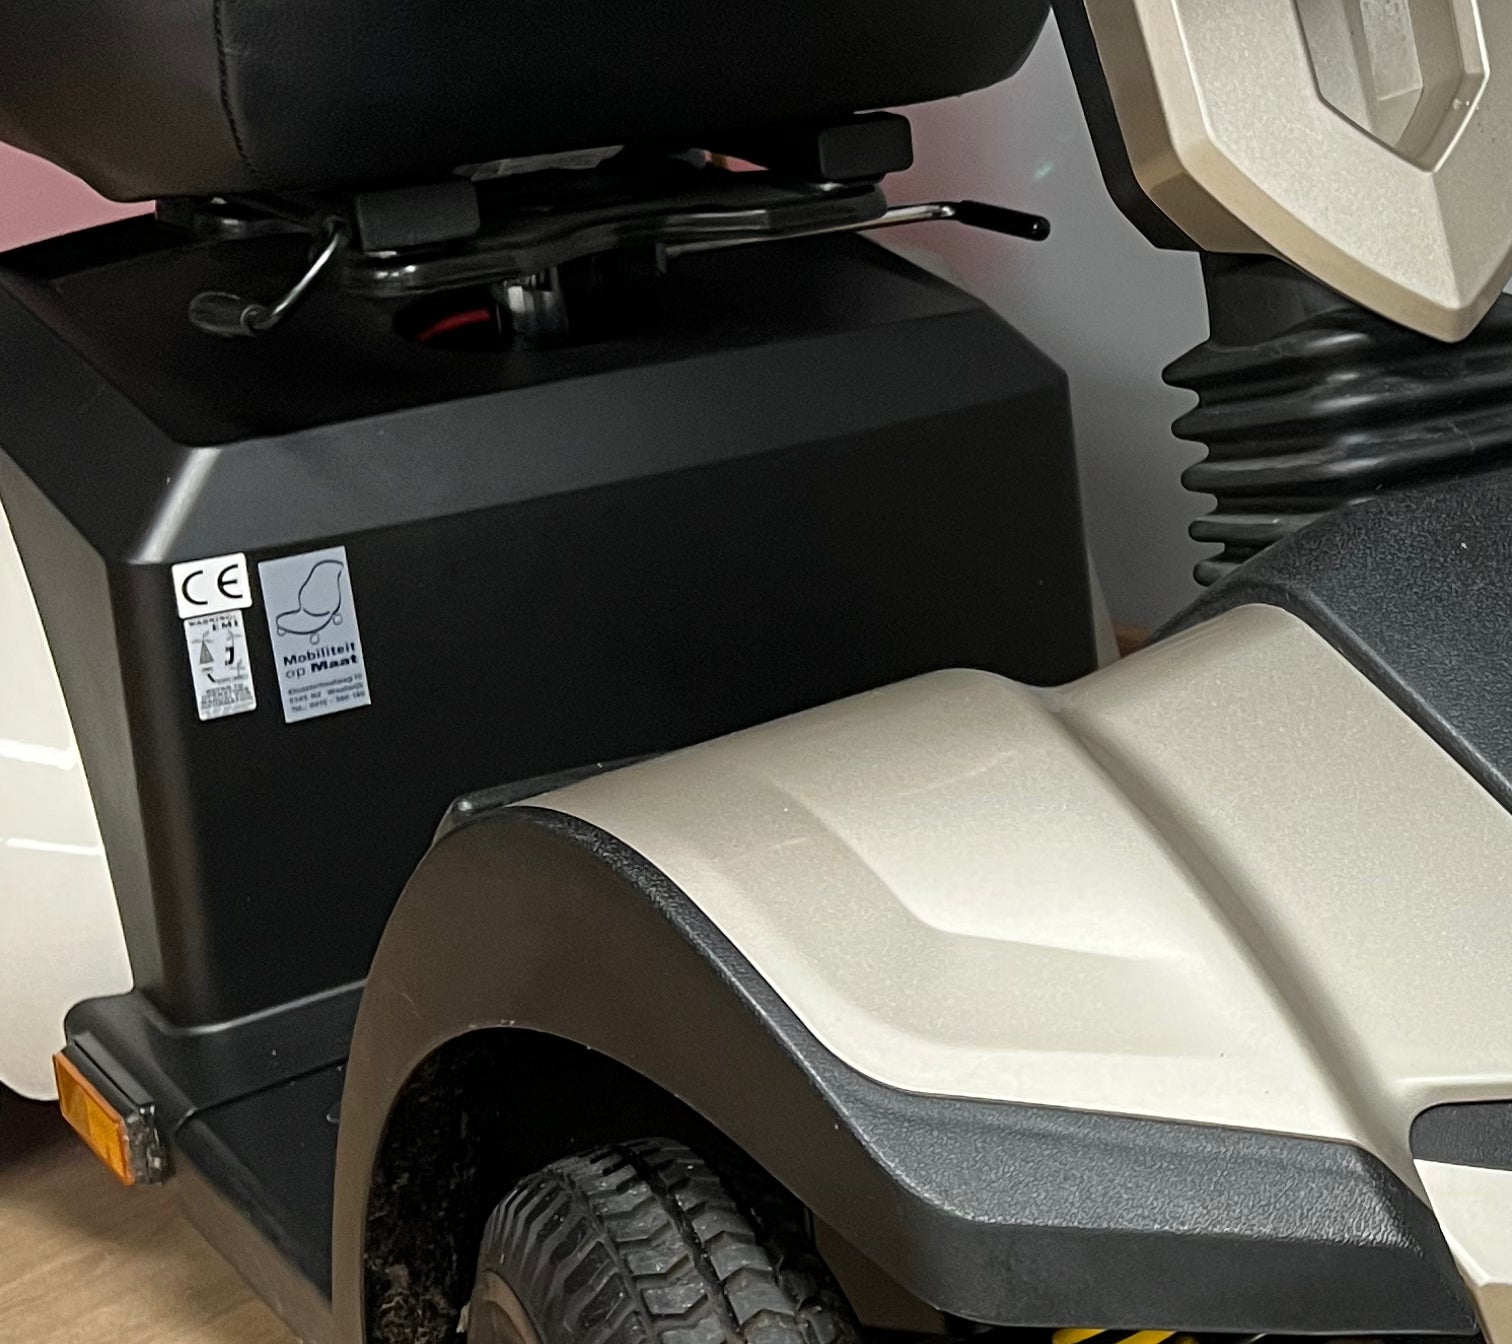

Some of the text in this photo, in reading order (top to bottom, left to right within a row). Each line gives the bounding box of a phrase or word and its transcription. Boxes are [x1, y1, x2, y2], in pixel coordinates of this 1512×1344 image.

[283, 642, 356, 667] Mobiliteit
[286, 654, 357, 679] op Maat
